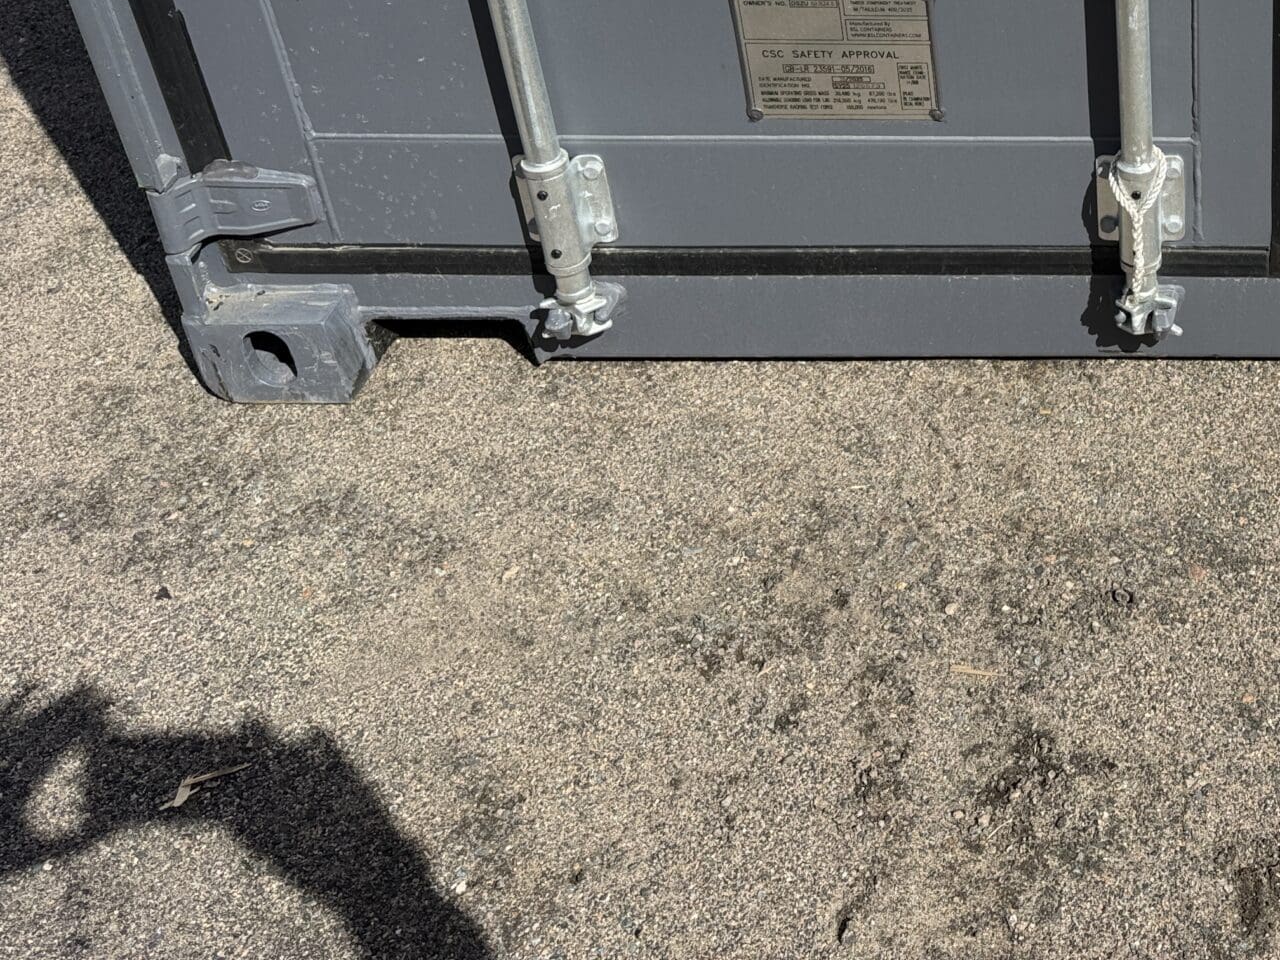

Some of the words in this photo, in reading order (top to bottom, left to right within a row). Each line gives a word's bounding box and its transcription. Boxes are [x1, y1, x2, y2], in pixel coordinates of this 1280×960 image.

[761, 49, 785, 58] CSC
[792, 50, 833, 59] SAFETY
[841, 50, 900, 59] APPROVAL
